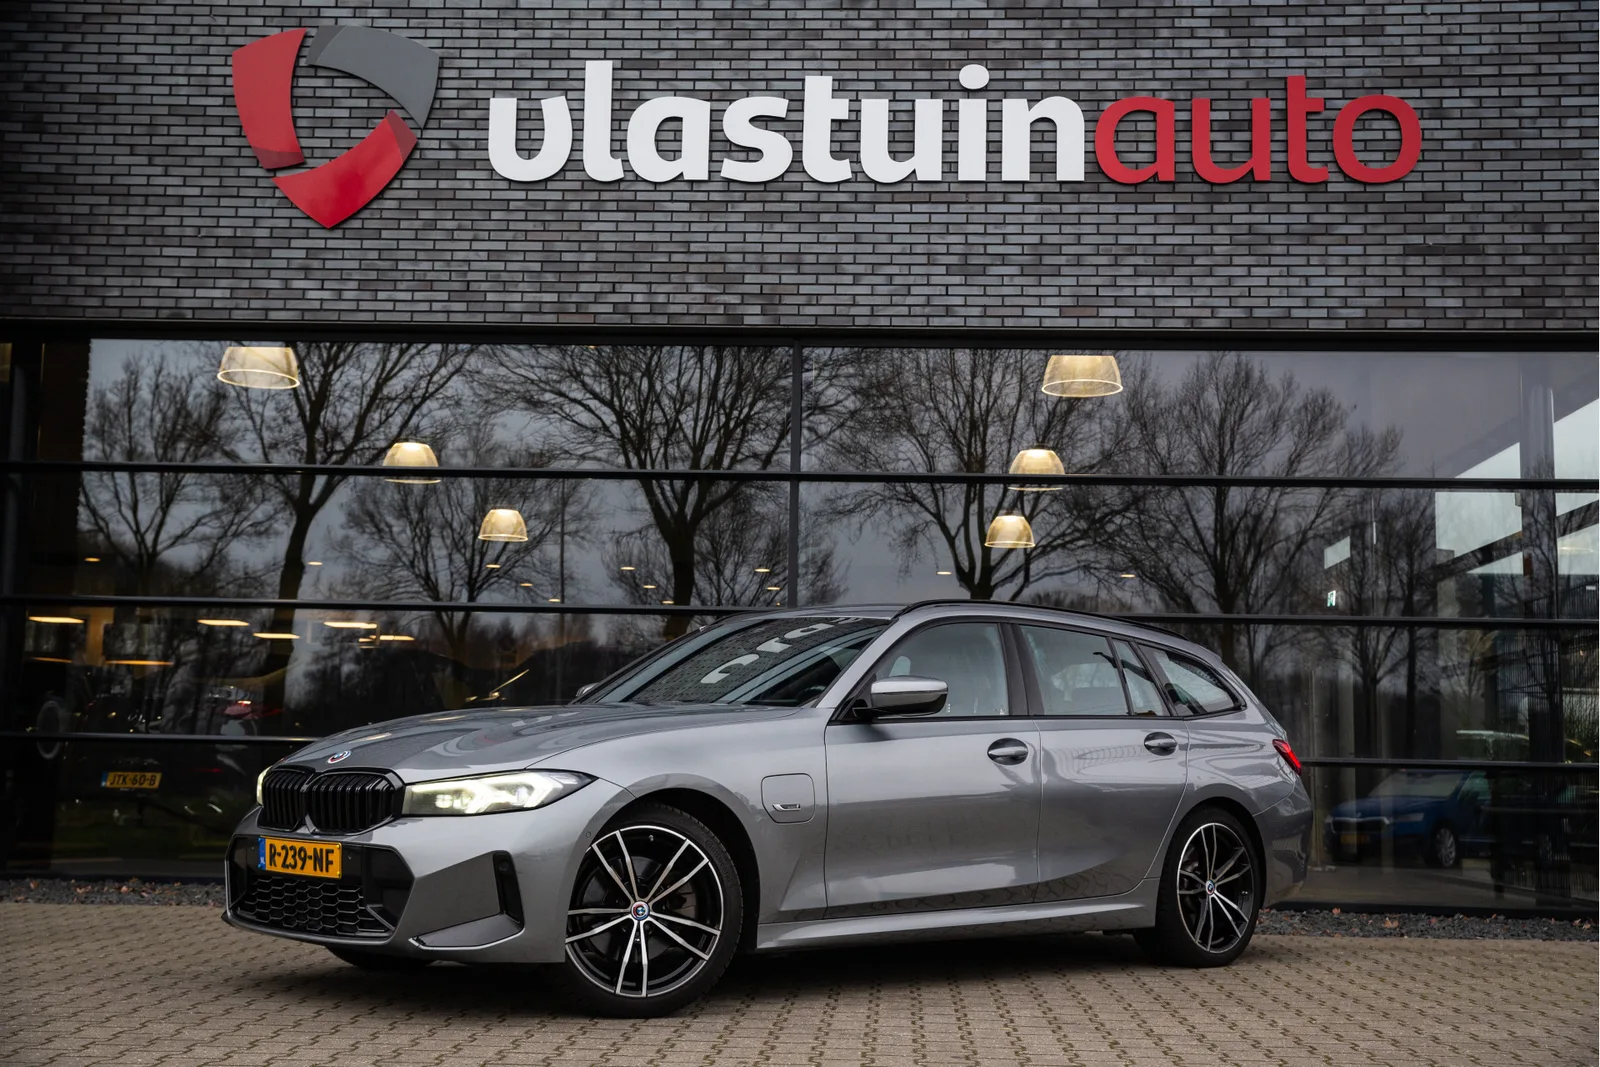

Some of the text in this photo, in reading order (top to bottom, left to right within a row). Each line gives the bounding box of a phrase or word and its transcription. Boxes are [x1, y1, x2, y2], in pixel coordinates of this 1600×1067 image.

[488, 60, 1422, 184] vlastuinauto
[109, 774, 157, 786] JTK-60-B
[269, 843, 335, 873] R-239-NF
